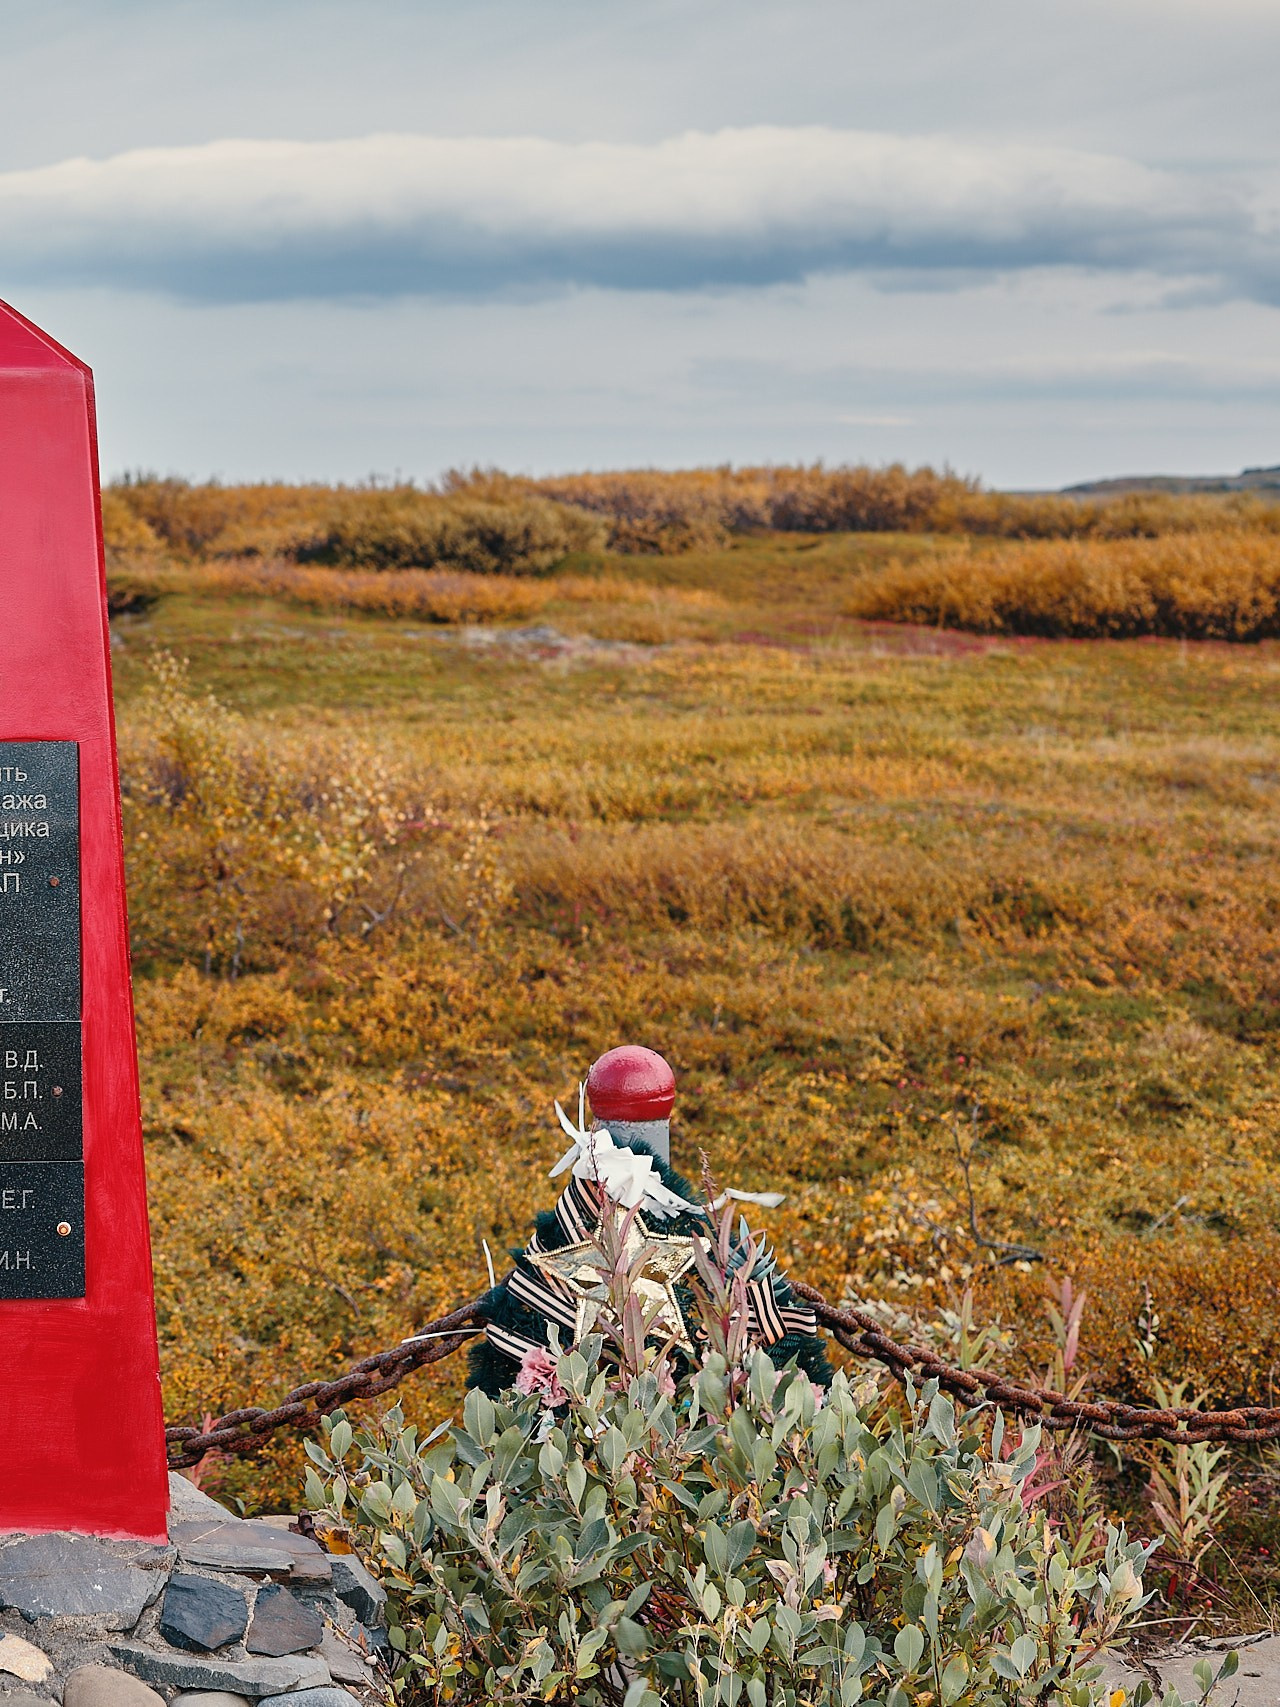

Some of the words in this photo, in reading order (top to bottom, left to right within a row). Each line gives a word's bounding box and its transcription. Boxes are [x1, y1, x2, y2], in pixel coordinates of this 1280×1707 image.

[6, 1050, 44, 1070] В.Д.
[4, 1081, 43, 1100] Б.П.
[1, 1112, 42, 1130] М.А.
[2, 1190, 35, 1210] Е.Г.
